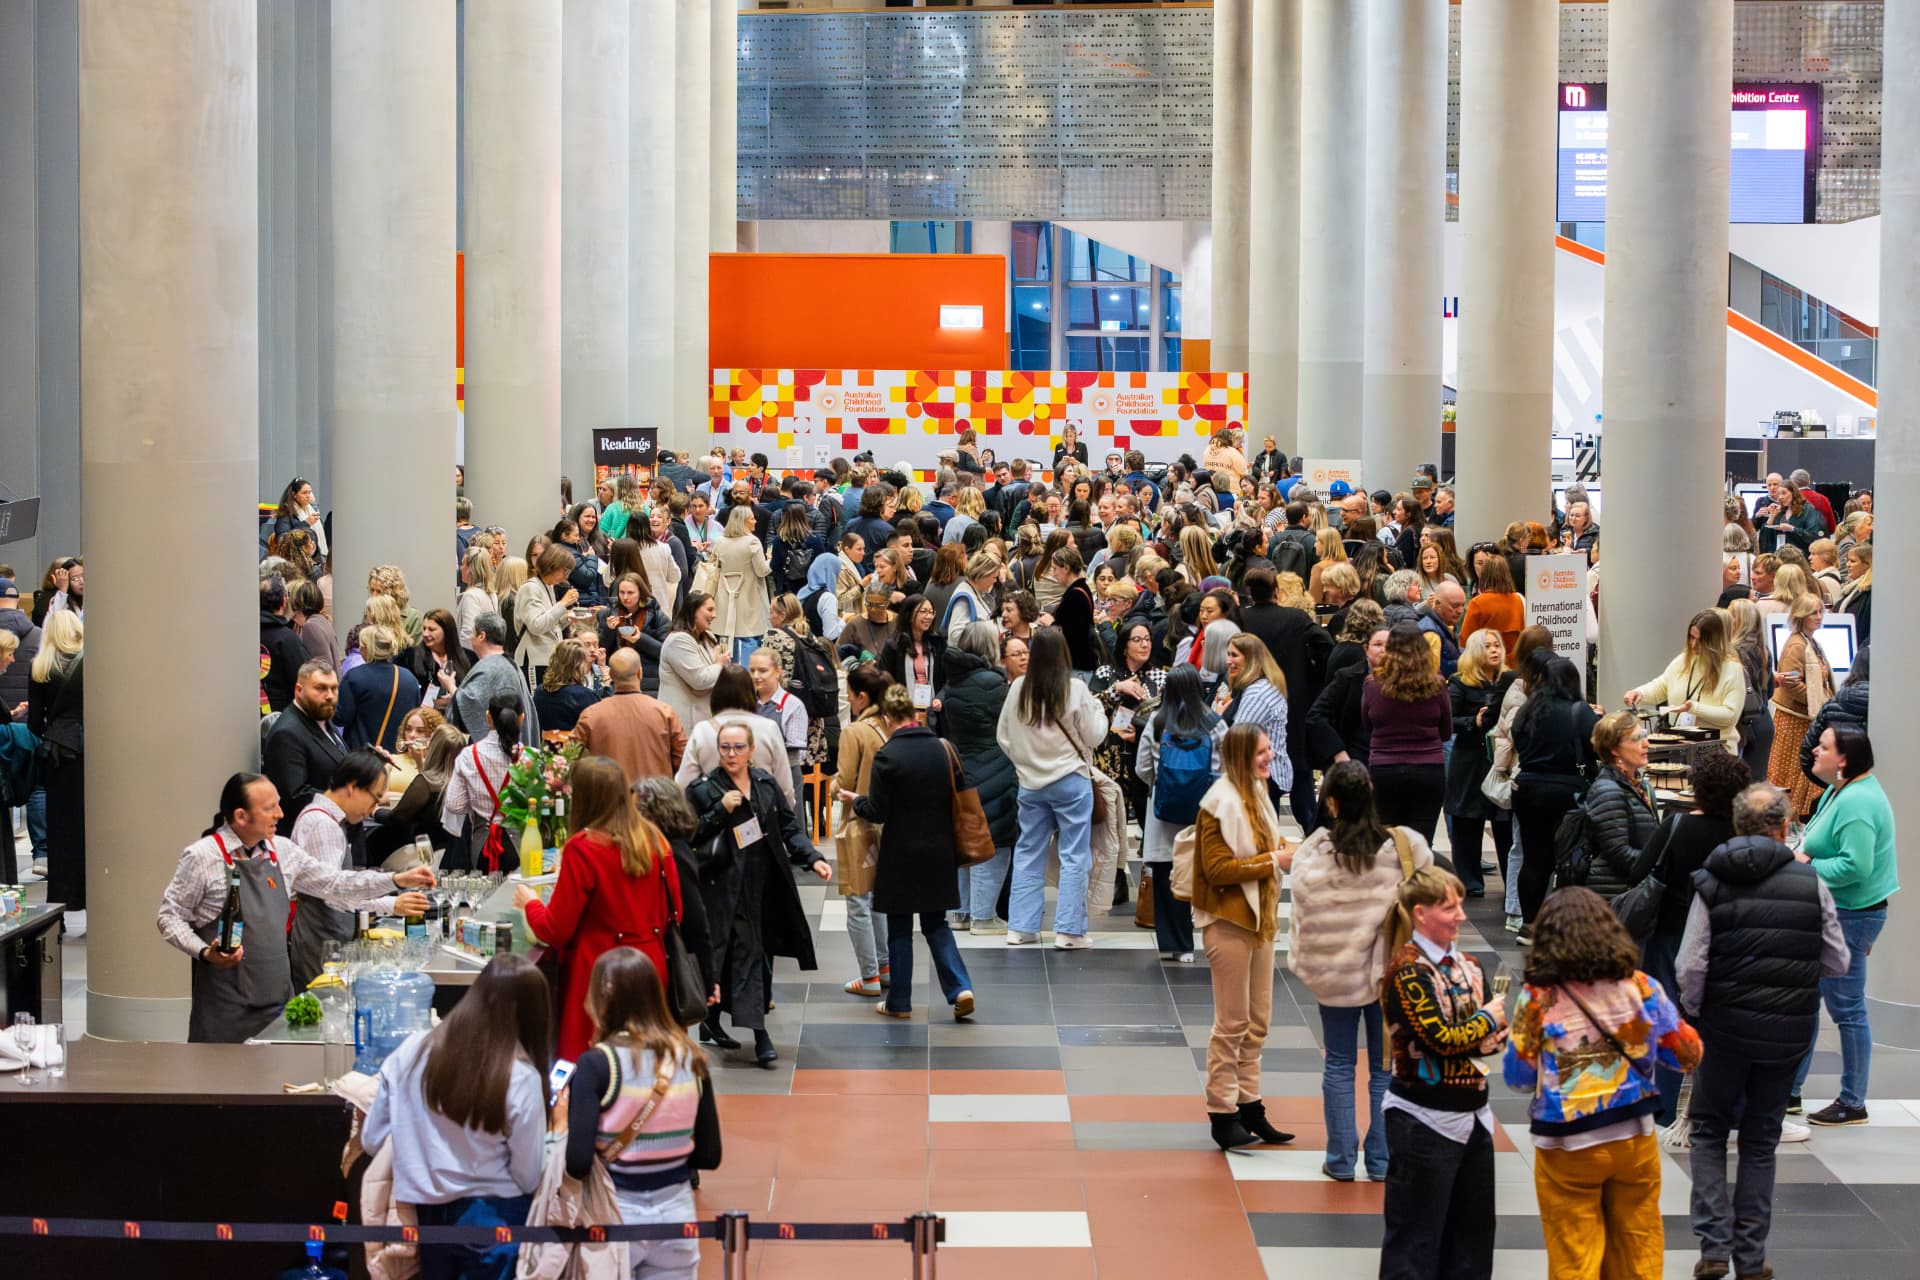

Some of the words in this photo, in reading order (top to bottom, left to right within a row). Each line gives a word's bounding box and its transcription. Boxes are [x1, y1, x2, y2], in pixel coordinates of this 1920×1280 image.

[1731, 92, 1766, 103] hibition
[1768, 92, 1800, 103] Centre
[844, 405, 886, 413] Foundation
[601, 437, 651, 453] Readings
[1531, 600, 1583, 613] International
[1536, 614, 1578, 626] Childhood
[1551, 630, 1572, 638] auma
[1553, 643, 1580, 651] erence
